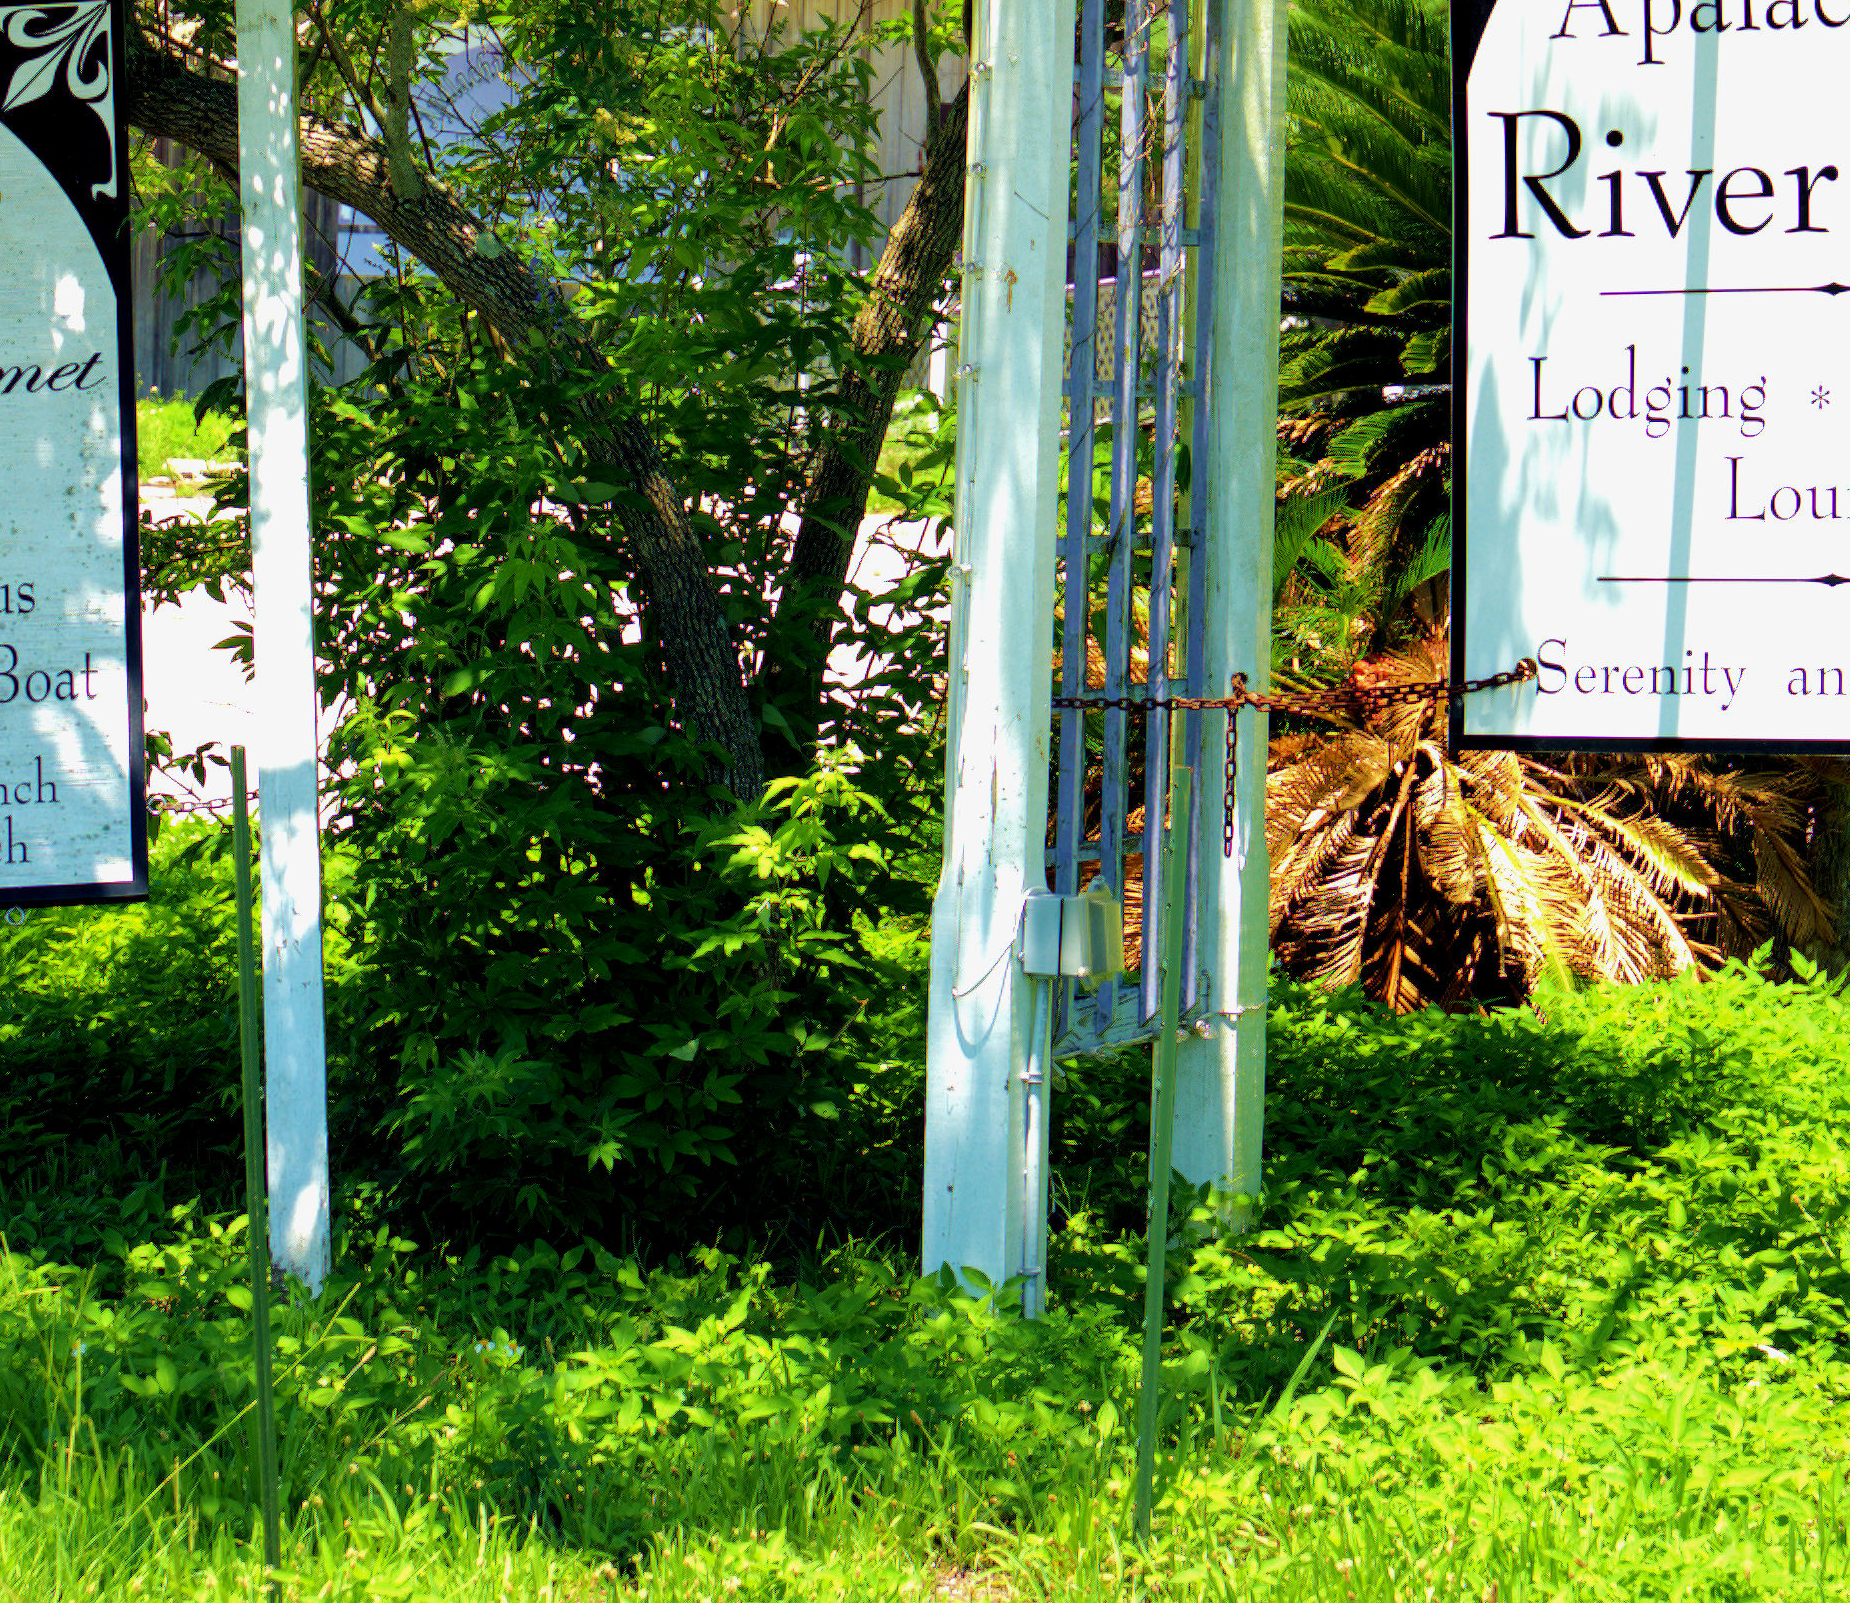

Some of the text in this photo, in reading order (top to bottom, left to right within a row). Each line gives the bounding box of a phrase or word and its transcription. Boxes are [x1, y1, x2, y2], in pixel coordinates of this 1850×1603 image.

[1486, 109, 1839, 240] River
[1526, 343, 1767, 438] Lodging
[1534, 637, 1748, 711] Serenity
